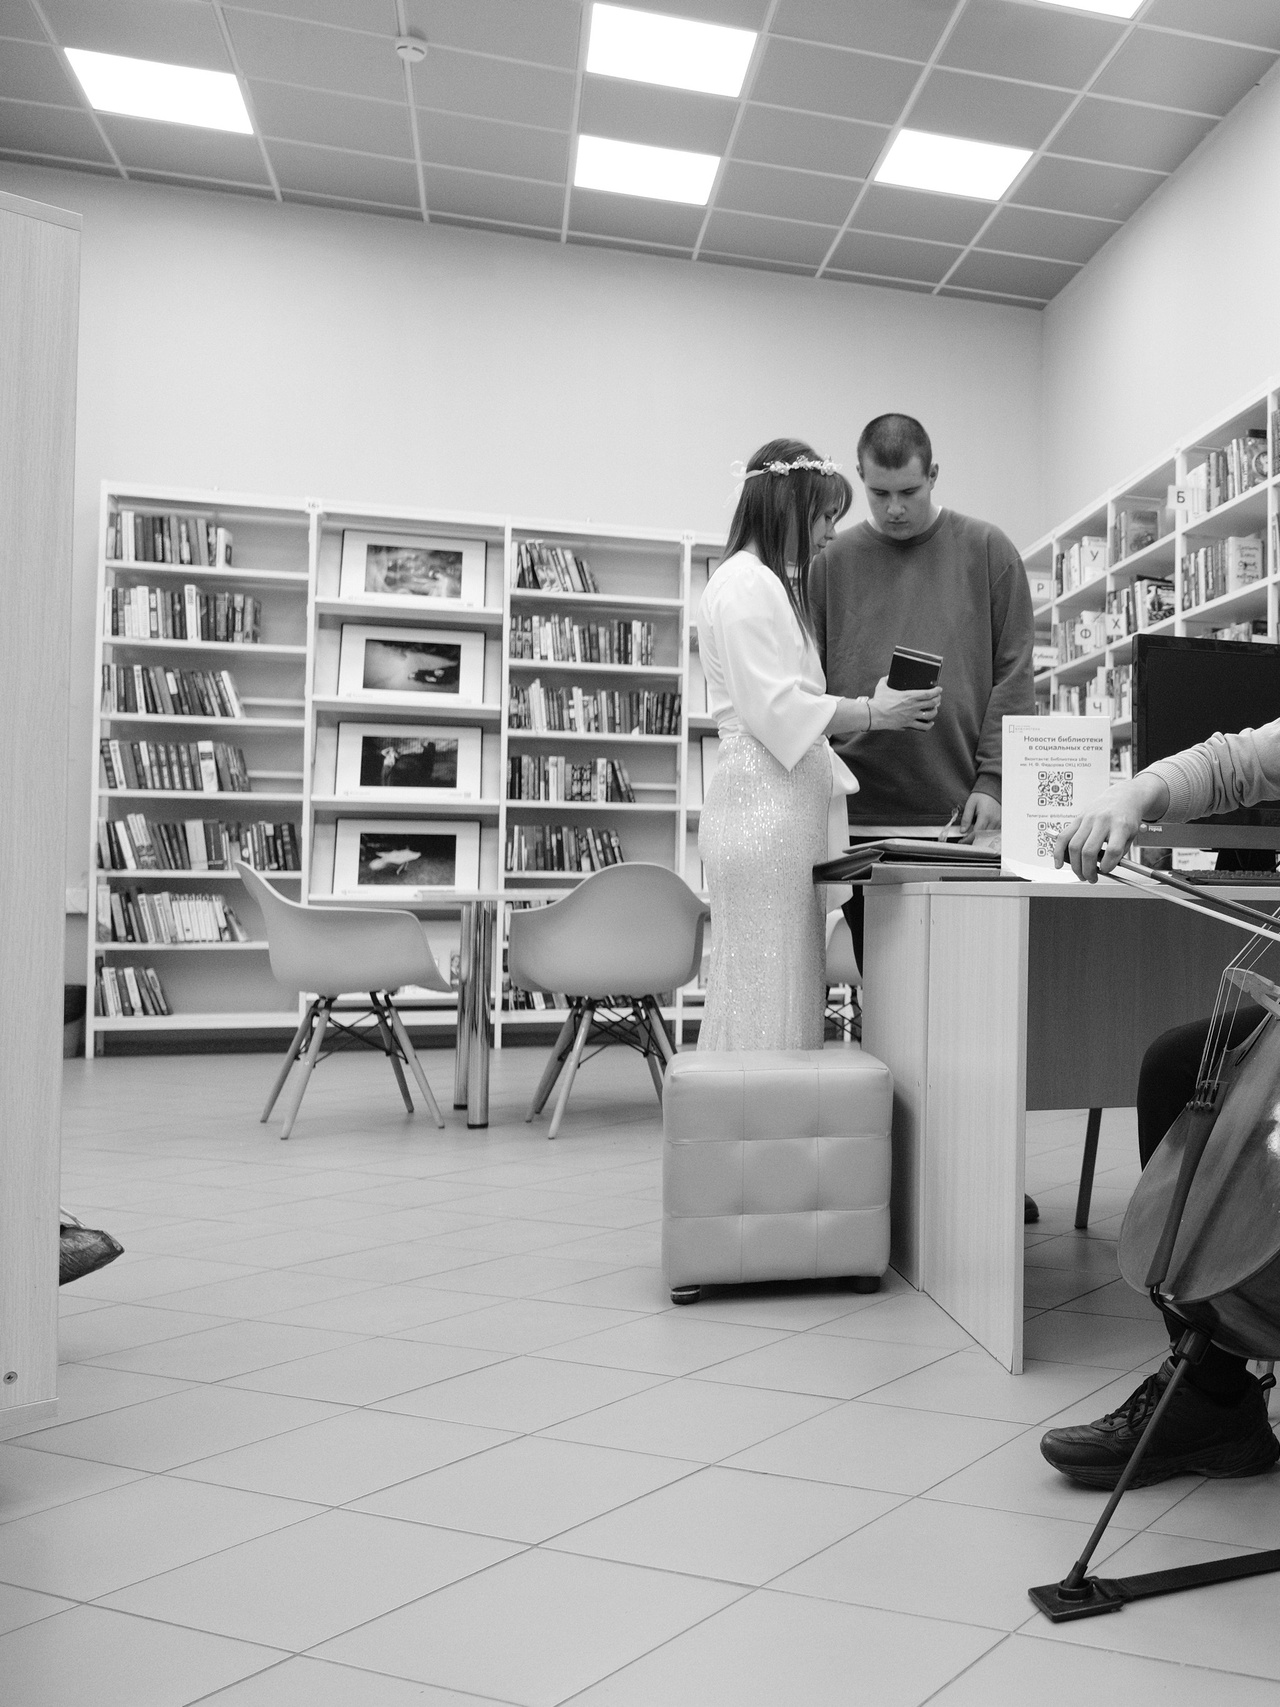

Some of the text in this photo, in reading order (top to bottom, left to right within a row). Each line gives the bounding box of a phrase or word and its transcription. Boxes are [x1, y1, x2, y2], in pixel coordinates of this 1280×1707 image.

[1176, 491, 1185, 504] Б
[1112, 618, 1121, 630] Х
[1081, 628, 1091, 639] Ф
[1058, 735, 1103, 744] библиотеки
